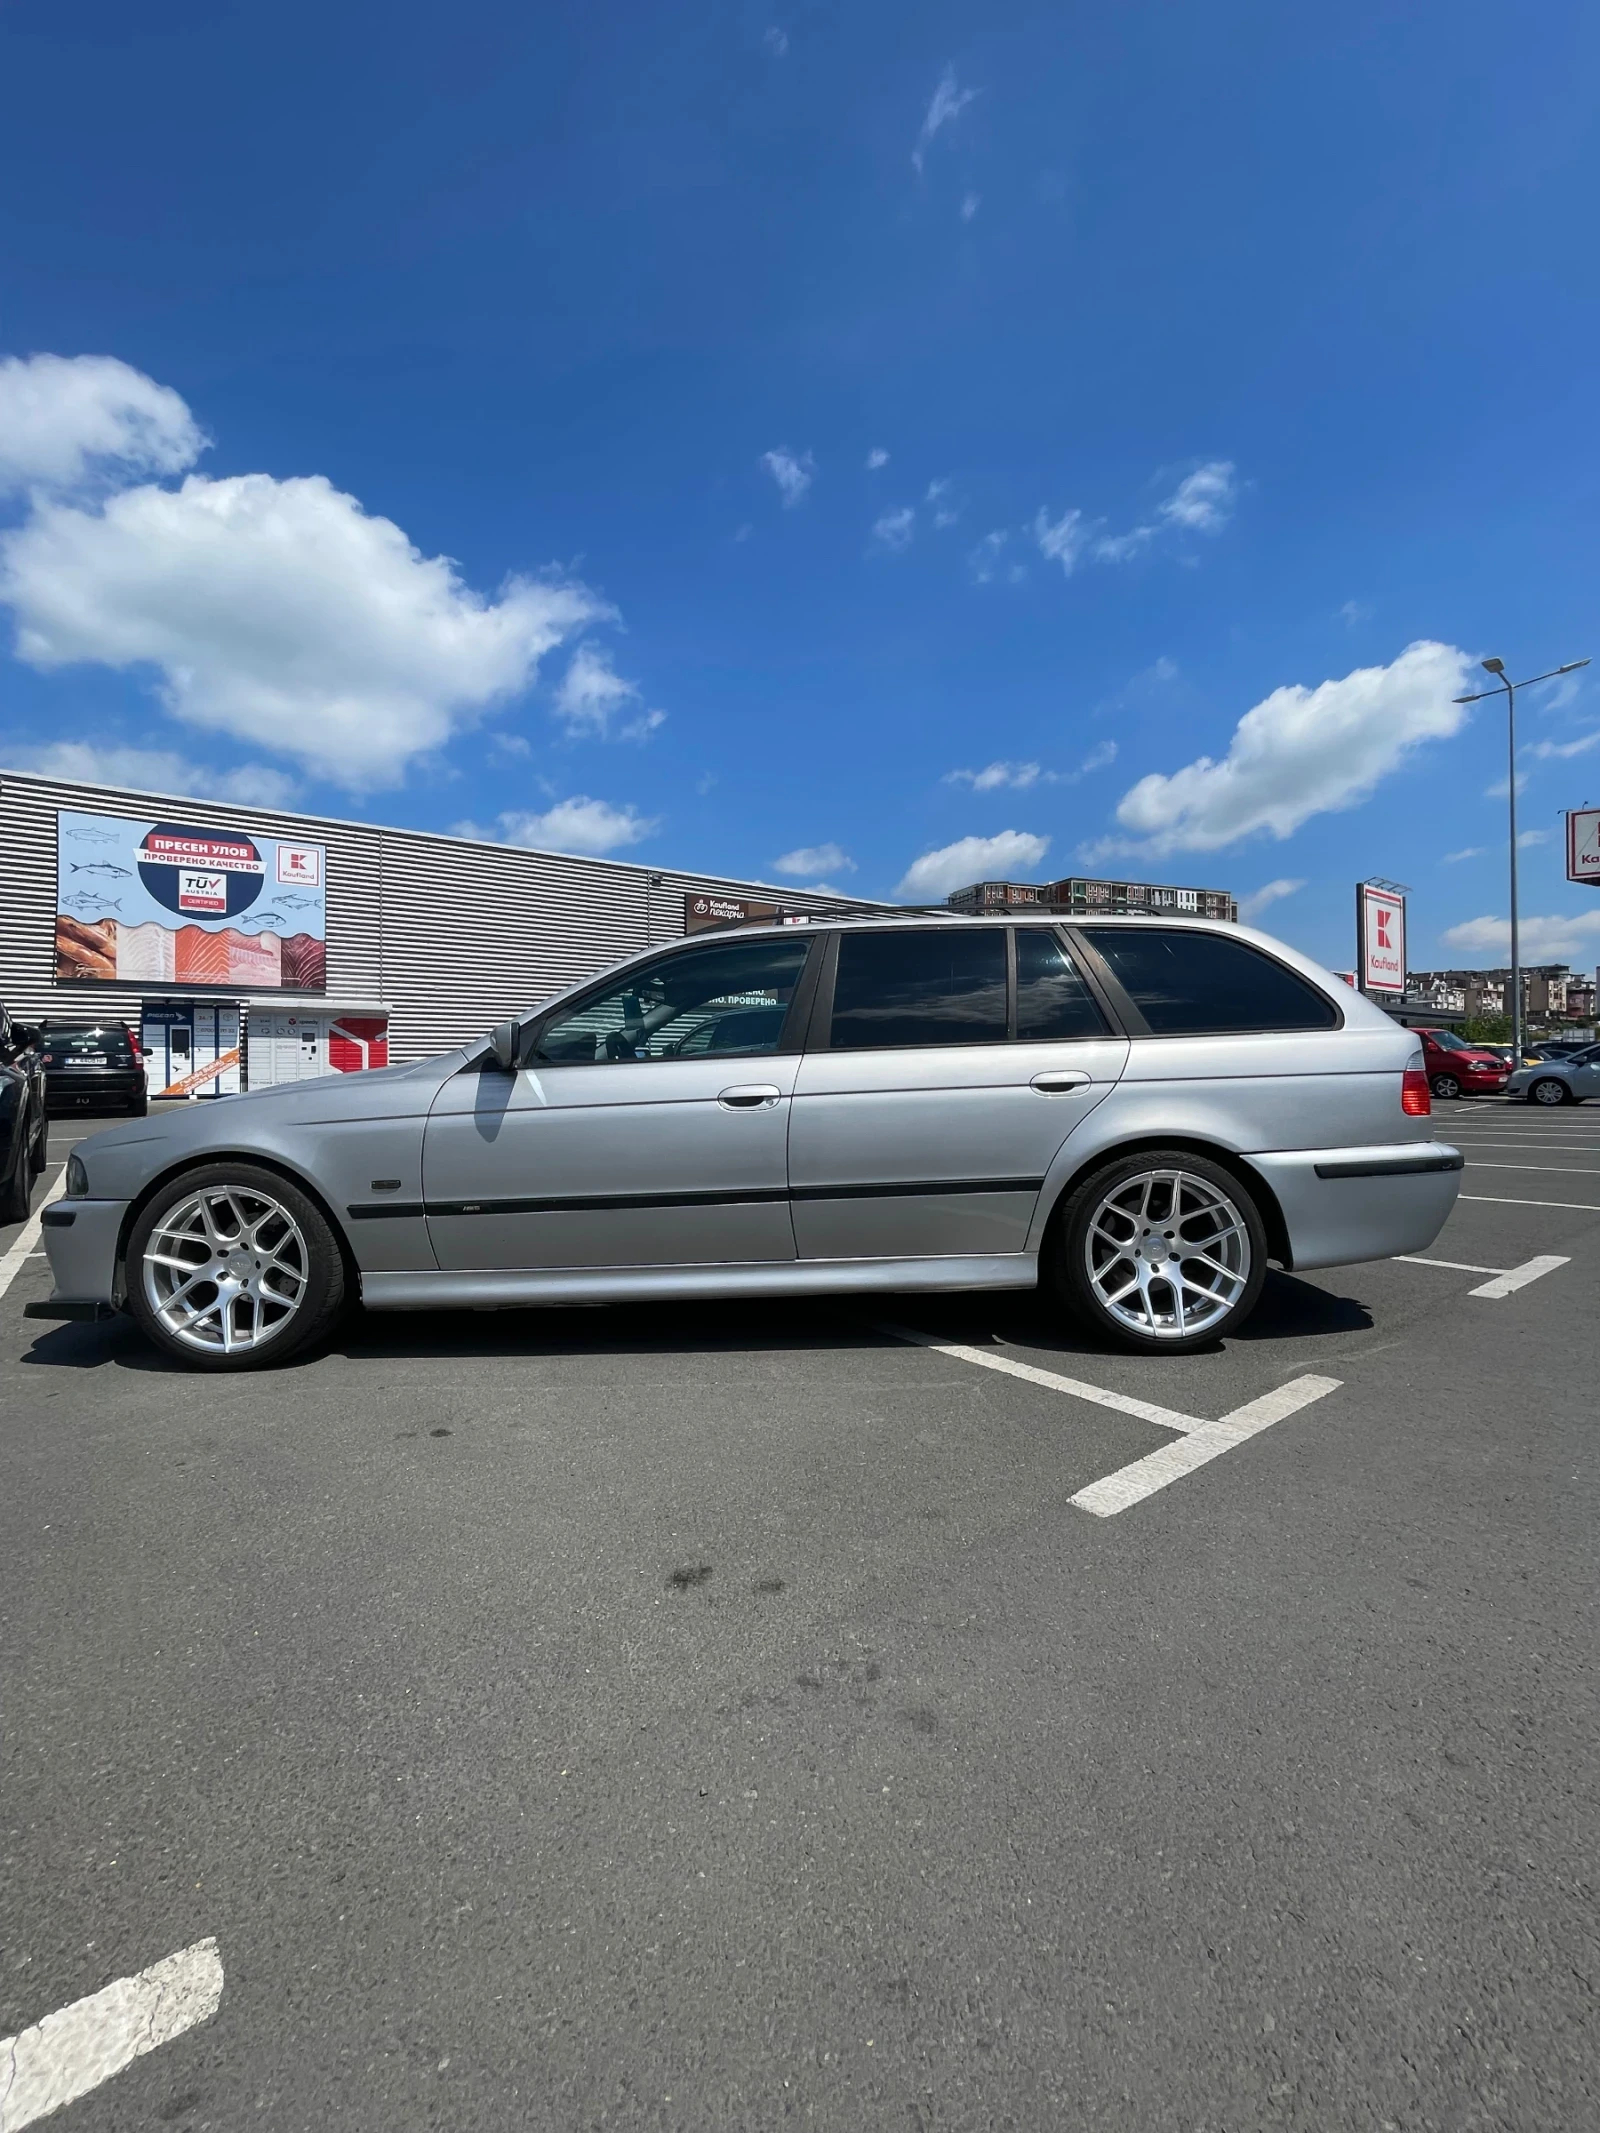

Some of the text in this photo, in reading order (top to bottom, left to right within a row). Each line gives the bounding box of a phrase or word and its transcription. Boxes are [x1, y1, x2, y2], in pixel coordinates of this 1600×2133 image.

[154, 839, 248, 857] ПРЕСЕН УЛОВ
[144, 853, 259, 871] ПРОВЕРЕНО КАЧЕСТВО
[282, 870, 315, 880] Kaufland
[187, 898, 219, 906] CERTIFIED
[709, 900, 740, 910] Kaufland
[709, 908, 745, 919] пекарна
[1370, 954, 1399, 972] Kaufland
[728, 996, 777, 1006] ПРОВЕРЕНО
